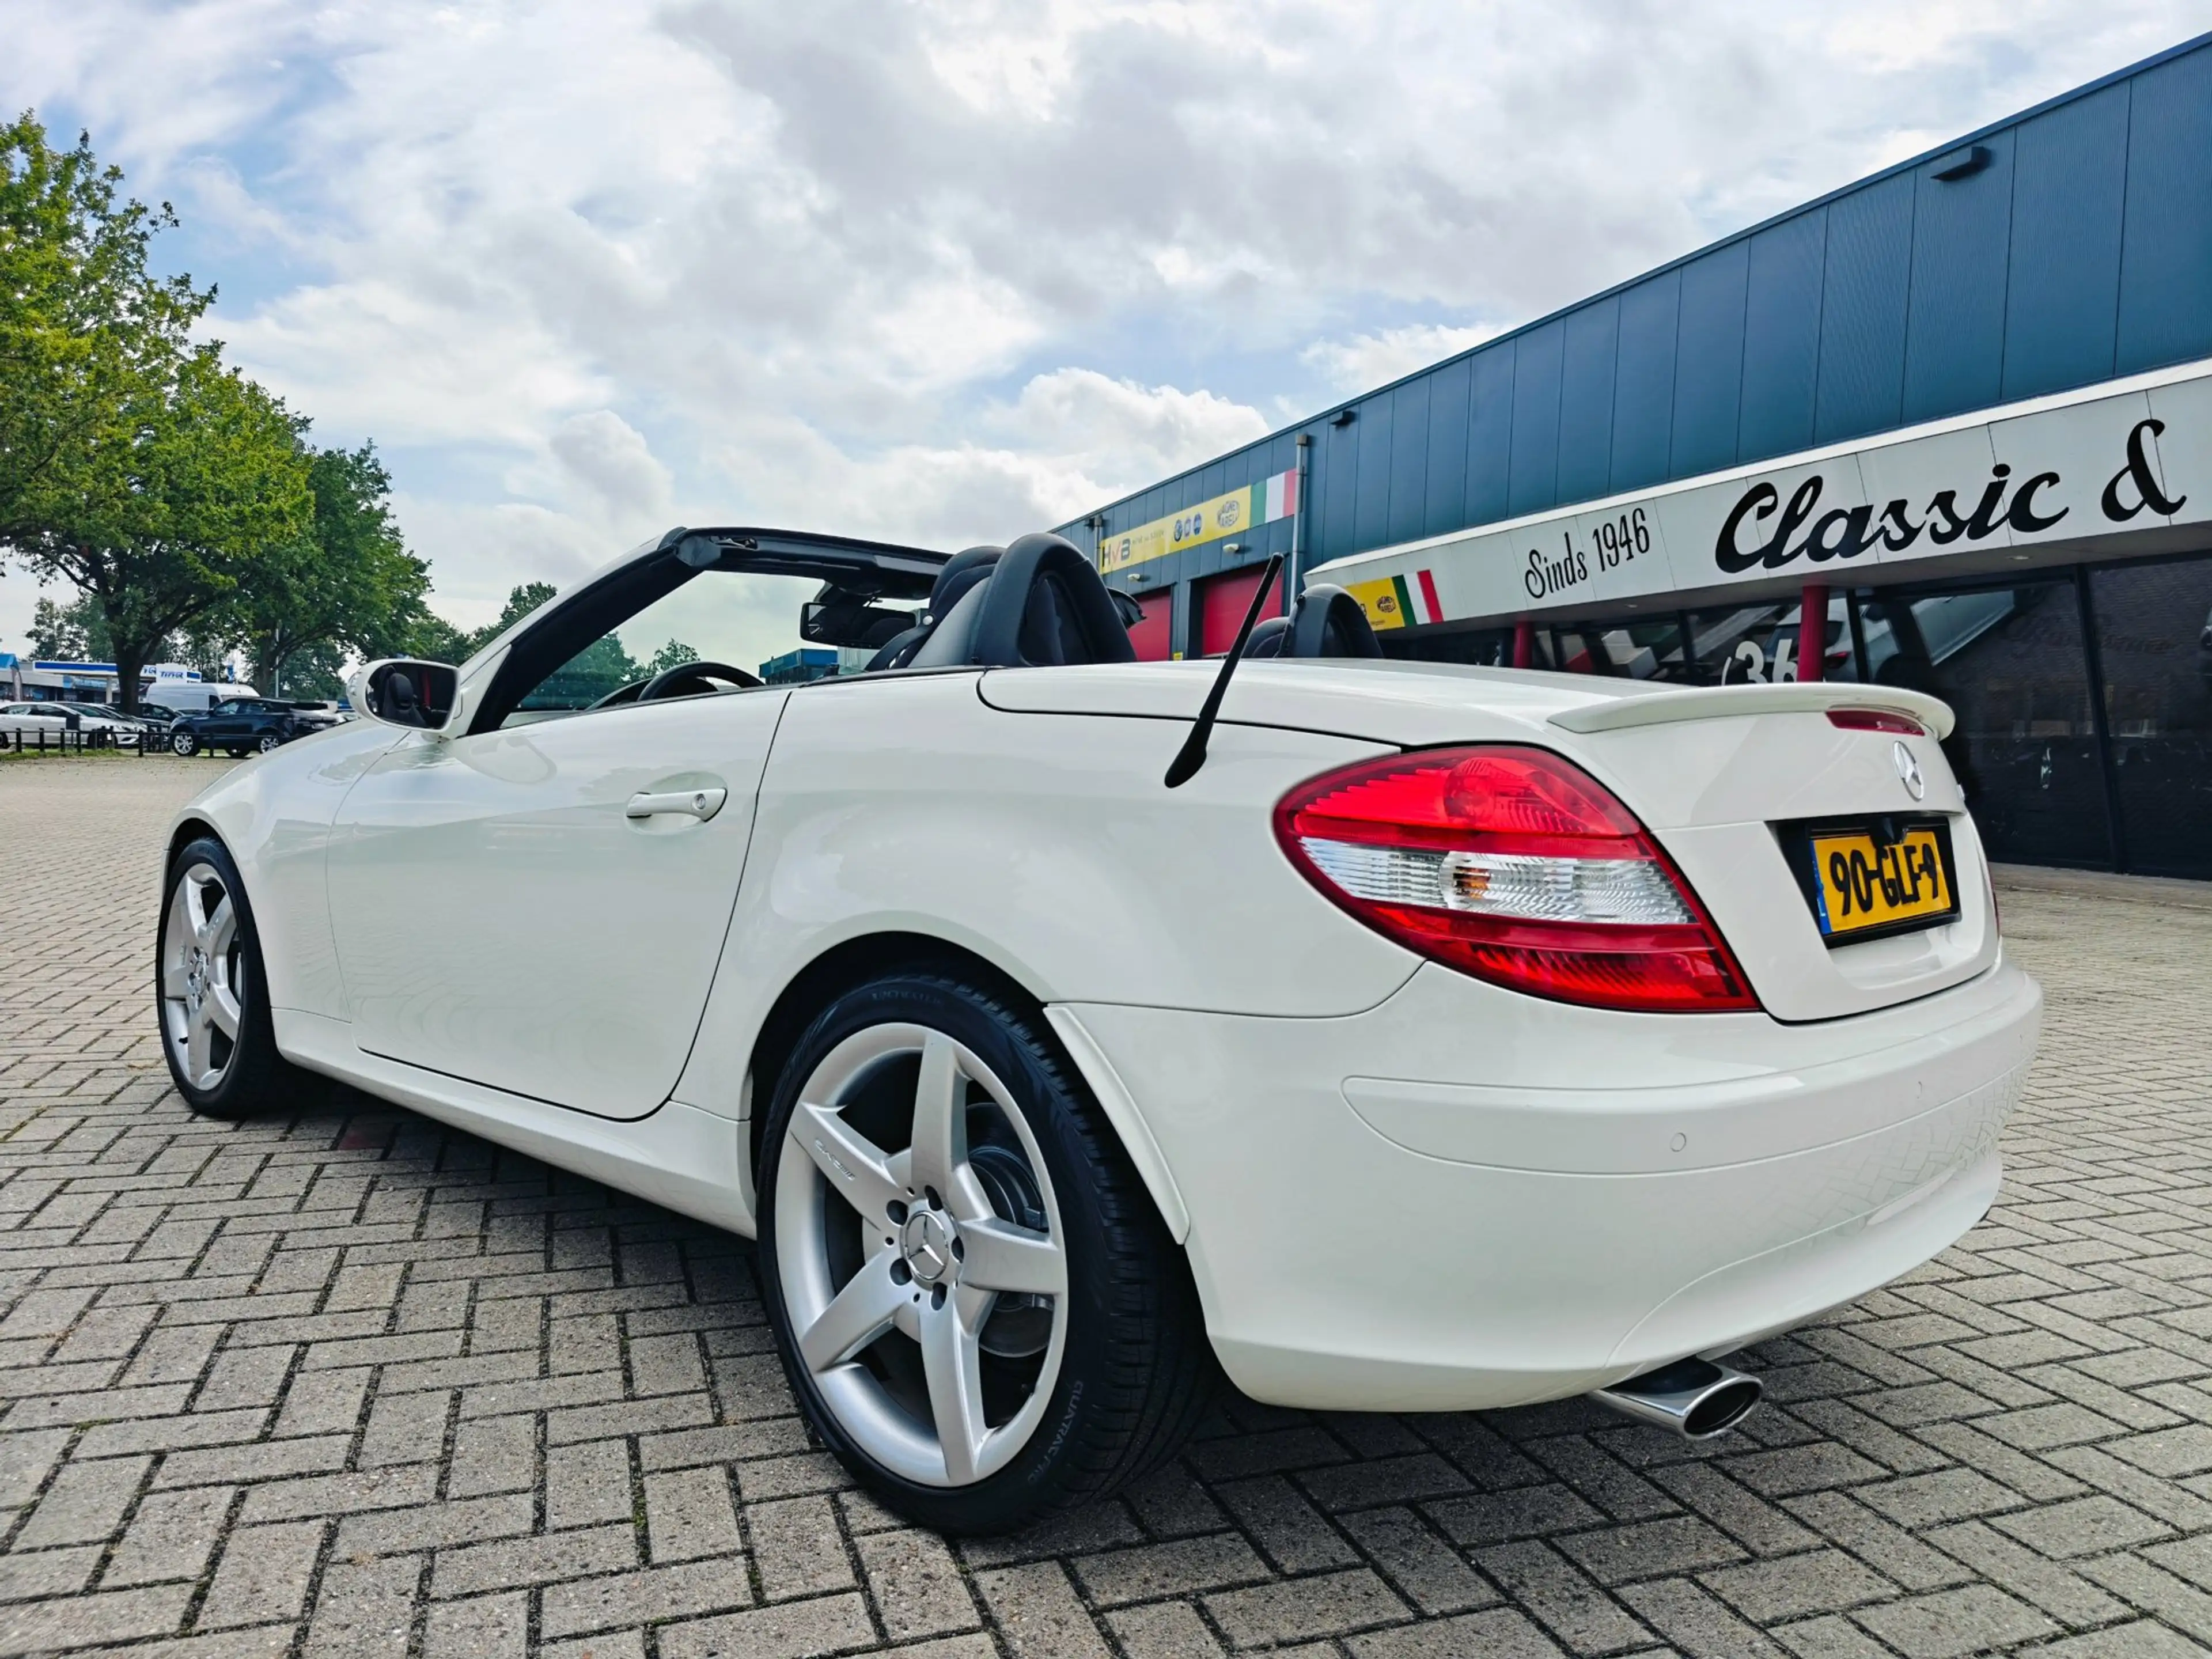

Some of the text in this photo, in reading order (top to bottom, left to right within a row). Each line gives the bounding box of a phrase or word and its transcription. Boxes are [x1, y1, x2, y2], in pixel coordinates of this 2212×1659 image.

[1524, 507, 1650, 599] Sinds 1946
[1715, 463, 2070, 574] Classic
